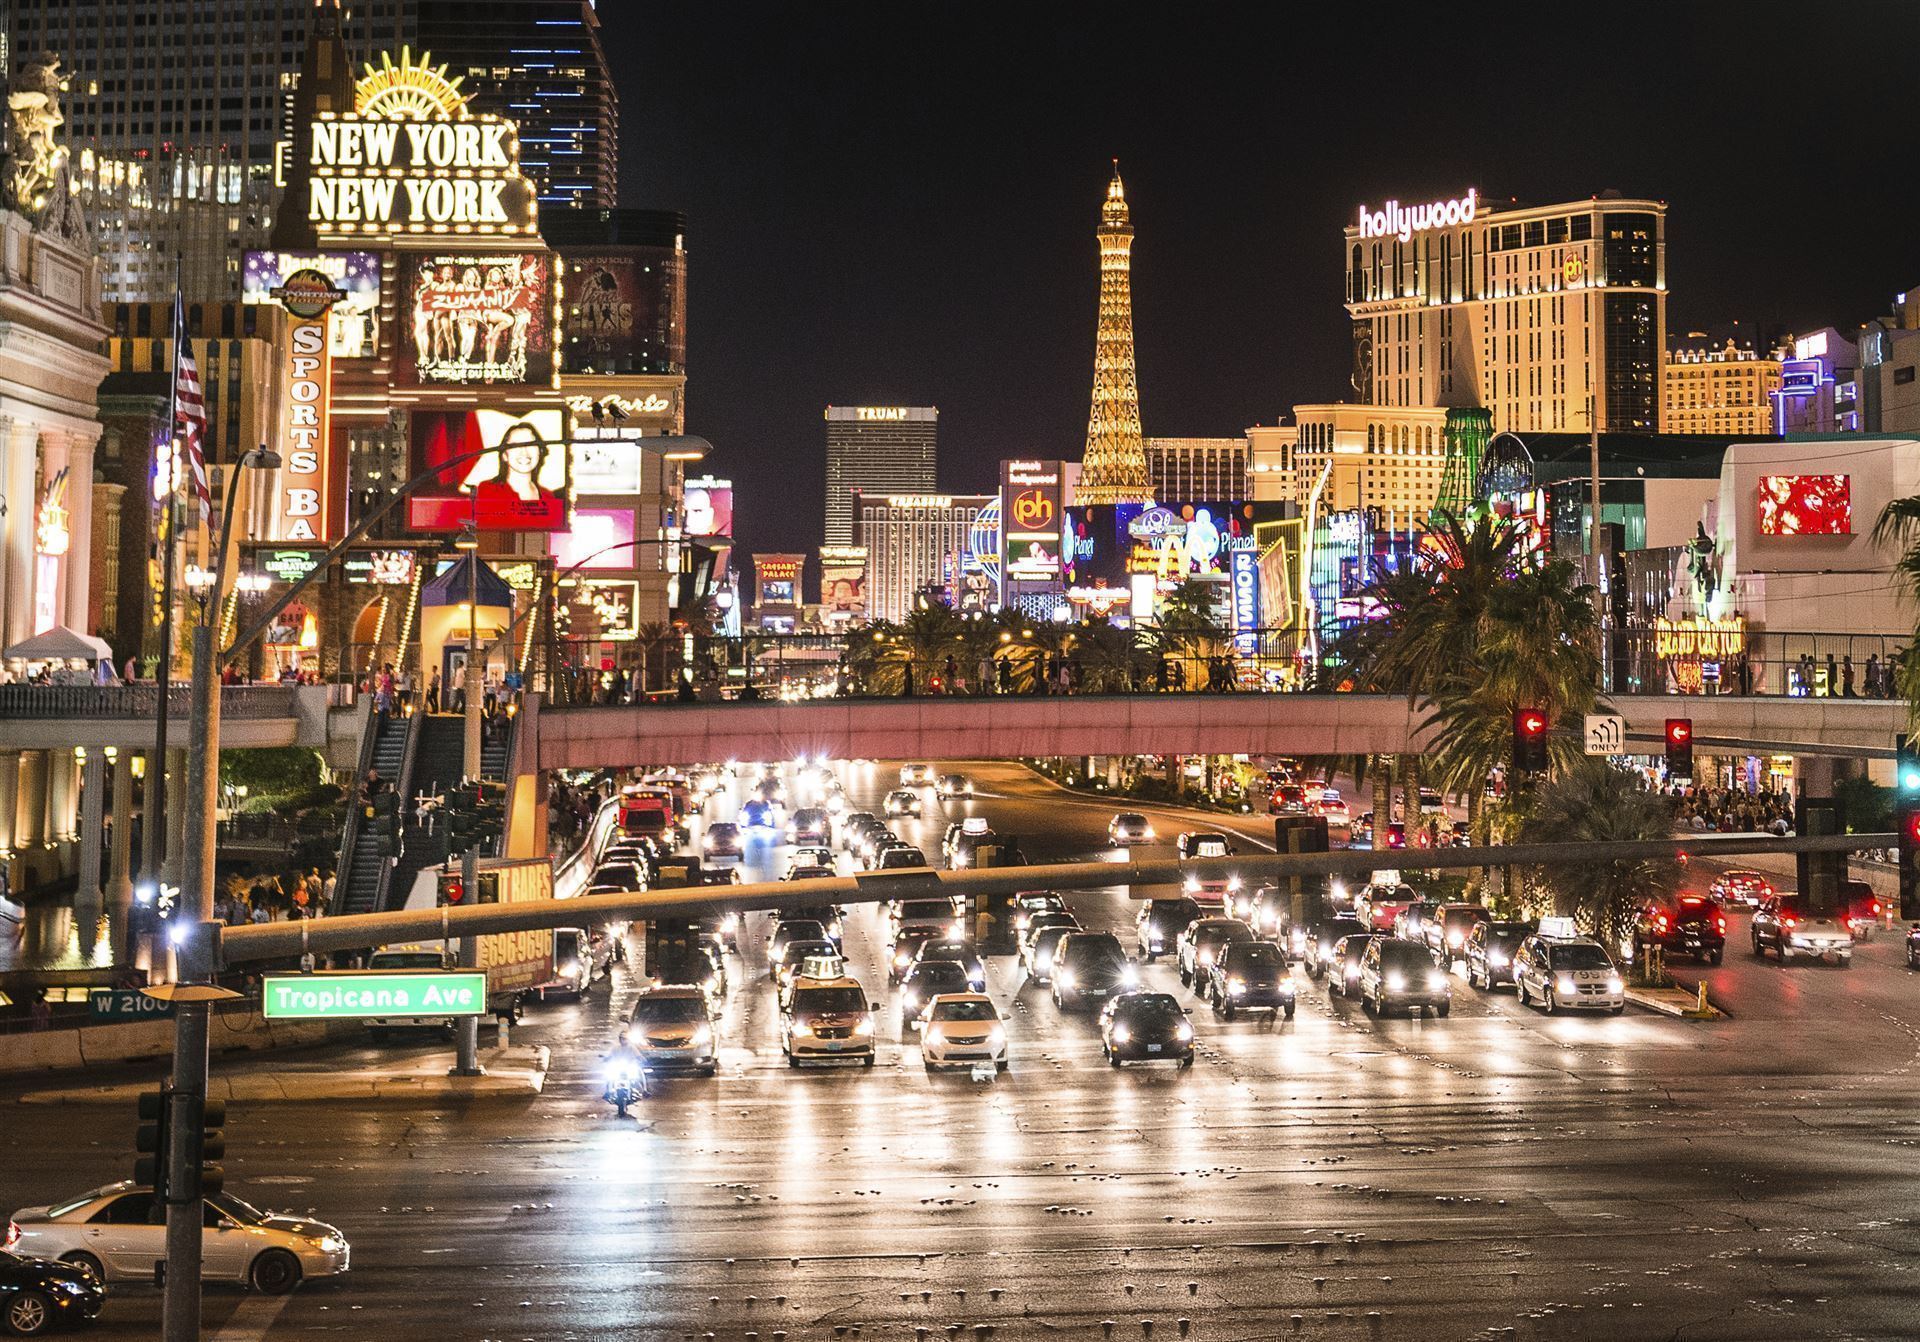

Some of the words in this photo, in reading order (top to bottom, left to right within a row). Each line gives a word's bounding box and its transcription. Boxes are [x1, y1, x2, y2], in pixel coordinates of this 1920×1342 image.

[310, 122, 399, 166] NEW
[405, 123, 509, 167] YORK
[308, 177, 398, 221] NEW
[403, 178, 508, 222] YORK
[1359, 187, 1476, 243] hollywood
[278, 253, 347, 278] Dancing
[1564, 253, 1583, 281] ph
[430, 288, 521, 311] ZUMANITY
[431, 368, 467, 380] CIRQUE
[468, 369, 482, 379] DU
[288, 325, 324, 475] SPORTS
[857, 407, 907, 420] TRUMP
[285, 487, 320, 540] BA
[1018, 490, 1053, 523] ph
[1074, 535, 1095, 555] Planet
[1221, 532, 1255, 553] Planet
[762, 563, 797, 571] CAESARS
[763, 570, 795, 578] PALACE
[1236, 553, 1254, 623] ROSS
[1657, 616, 1696, 659] GRAND
[1696, 615, 1743, 657] CANYON
[1591, 743, 1619, 752] ONLY
[511, 863, 552, 903] BABES
[96, 996, 113, 1013] W
[121, 996, 170, 1013] 2100
[275, 985, 409, 1012] Tropicana
[422, 984, 473, 1007] Ave
